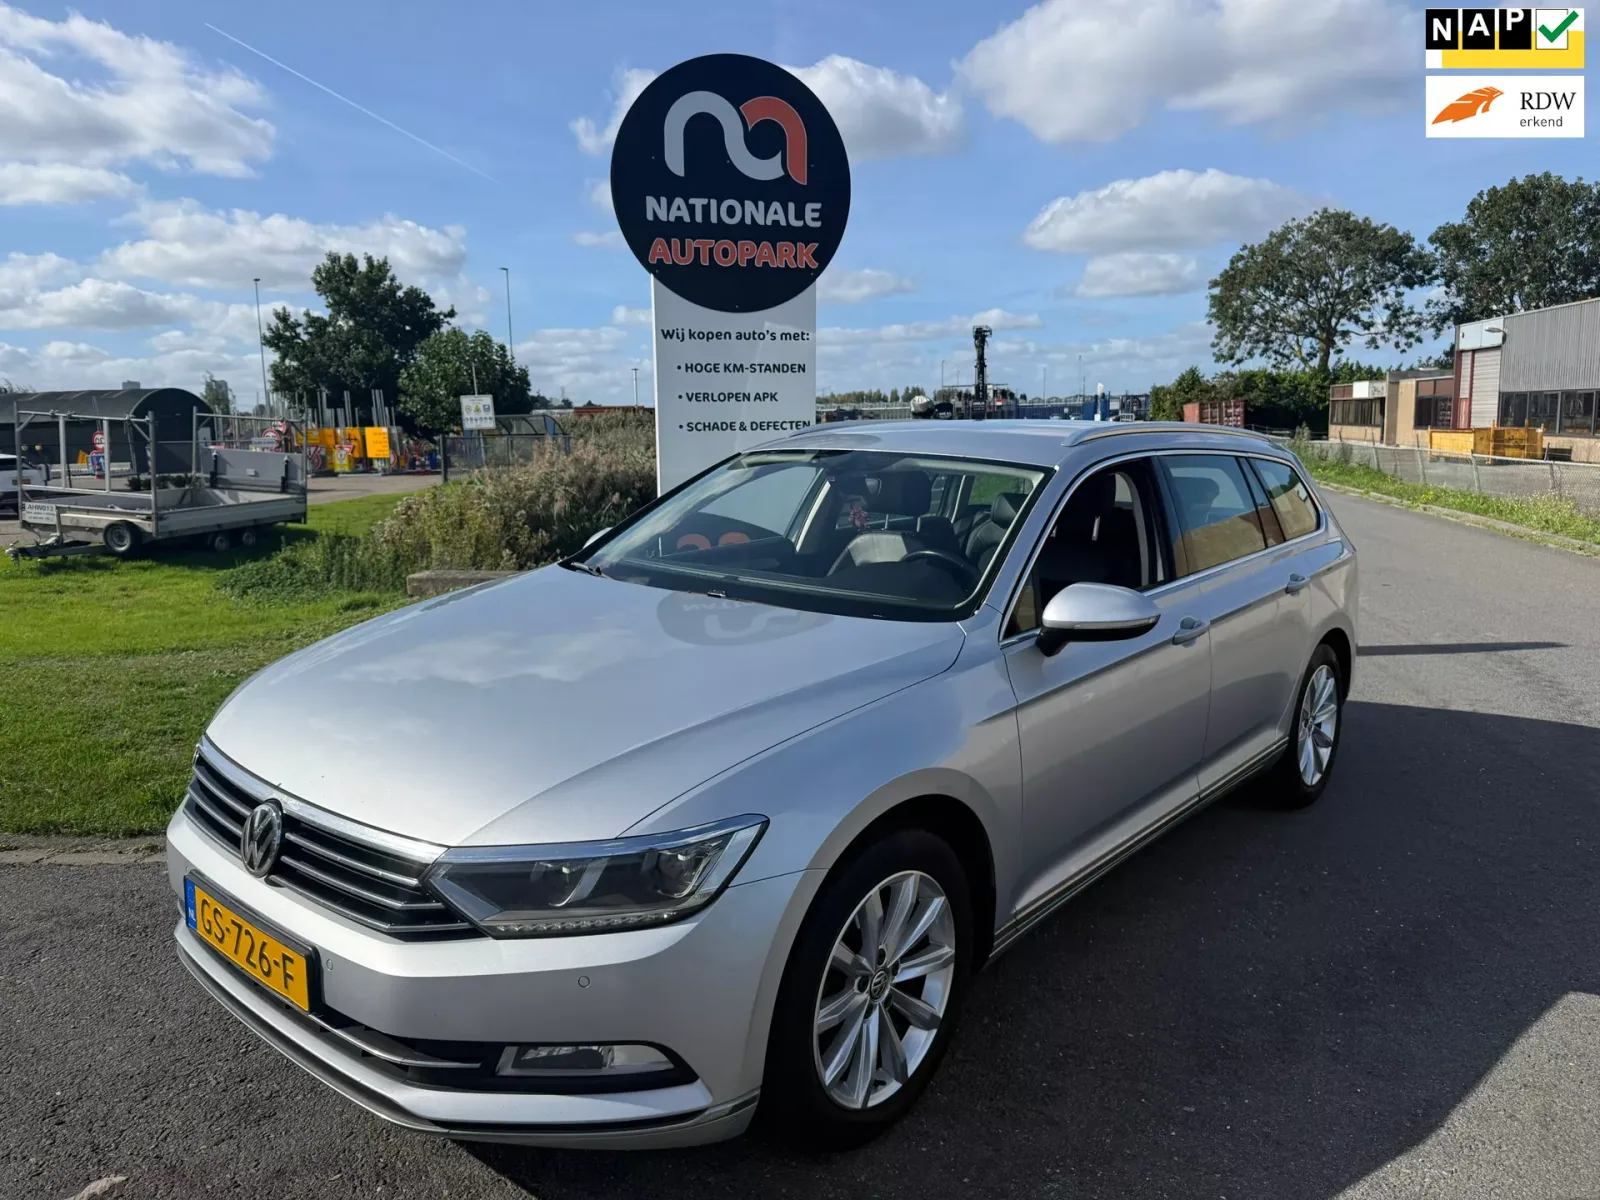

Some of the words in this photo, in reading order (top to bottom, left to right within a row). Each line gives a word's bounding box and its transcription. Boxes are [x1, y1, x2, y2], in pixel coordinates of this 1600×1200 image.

[645, 195, 822, 228] NATIONALE
[648, 237, 819, 269] AUTOPARK
[661, 328, 685, 342] Wij
[688, 328, 732, 342] kopen
[735, 329, 777, 341] auto's
[780, 331, 810, 341] met:
[684, 363, 721, 374] HOGE
[723, 363, 806, 374] KM-STANDEN
[686, 392, 751, 403] VERLOPEN
[753, 392, 779, 402] APK
[686, 421, 737, 432] SCHADE
[738, 421, 748, 432] &
[750, 420, 811, 431] DEFECTEN
[188, 907, 197, 922] NL
[201, 898, 295, 991] GS-726-F
